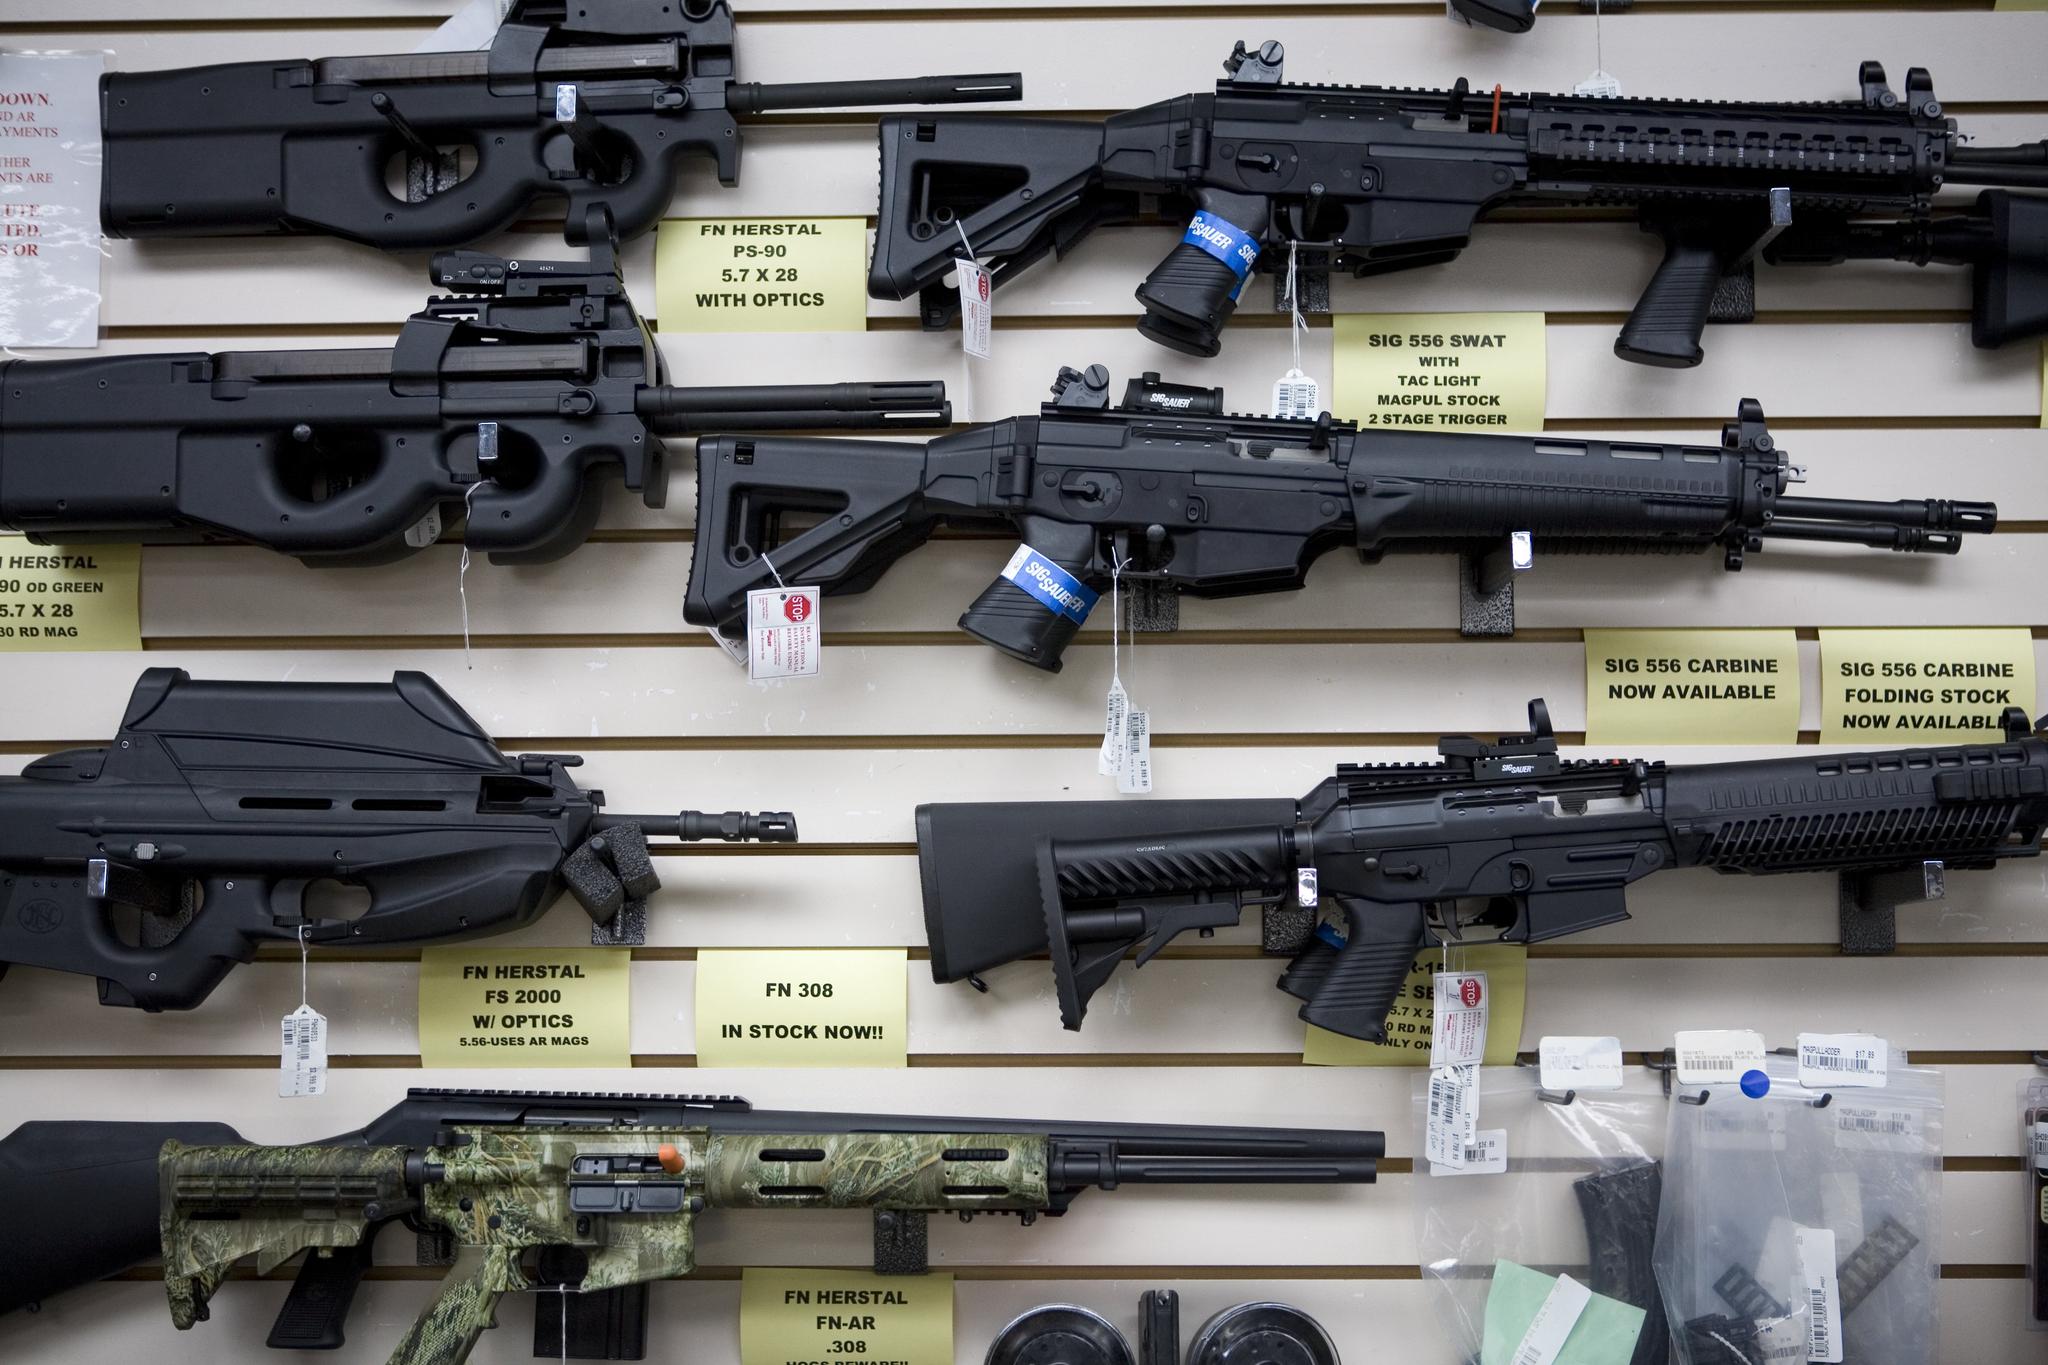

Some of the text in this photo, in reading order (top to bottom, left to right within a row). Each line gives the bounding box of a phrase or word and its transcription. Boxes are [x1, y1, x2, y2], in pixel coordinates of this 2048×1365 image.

[17, 112, 35, 122] AR
[0, 127, 58, 137] YMENTS
[26, 172, 53, 183] ARE
[700, 224, 822, 236] FN HERSTAL
[14, 243, 38, 257] OR
[733, 245, 786, 258] PS-90
[722, 268, 798, 282] 5.7 X 28
[695, 292, 825, 308] WITH OPTICS
[1368, 334, 1507, 348] SIG 556 SWAT
[1418, 356, 1460, 367] WITH
[1397, 375, 1481, 387] TAC LIGHT
[1377, 394, 1501, 406] MAGPUL STOCK
[1368, 413, 1507, 425] 2 STAGE TRIGGER
[9, 556, 98, 569] HERSTAL
[26, 582, 47, 593] OD
[52, 581, 103, 593] GREEN
[0, 603, 74, 618] 5.7 X 28
[792, 596, 804, 621] STOP
[19, 627, 39, 637] RD
[44, 627, 78, 637] MAG
[1605, 659, 1778, 673] SIG 556 CARBINE
[1840, 662, 2014, 677] SIG 556 CARBINE
[1608, 685, 1776, 699] NOW AVAILABLE
[1845, 689, 2011, 704] FOLDING STOCK
[1842, 715, 1891, 729] NOW
[463, 965, 585, 979] FN HERSTAL
[485, 989, 562, 1004] FS 2000
[766, 983, 833, 998] FN 308
[1466, 980, 1476, 1006] STOP
[1413, 1007, 1423, 1018] X
[1426, 1009, 1434, 1019] 2
[473, 1014, 574, 1029] W/ OPTICS
[1397, 1023, 1416, 1033] RD
[722, 1024, 884, 1040] IN STOCK NOW!!
[459, 1036, 589, 1046] 5.56-USES AR MAGS
[784, 1290, 908, 1305] FN HERSTAL
[816, 1315, 876, 1330] FN-AR
[826, 1340, 867, 1353] .308
